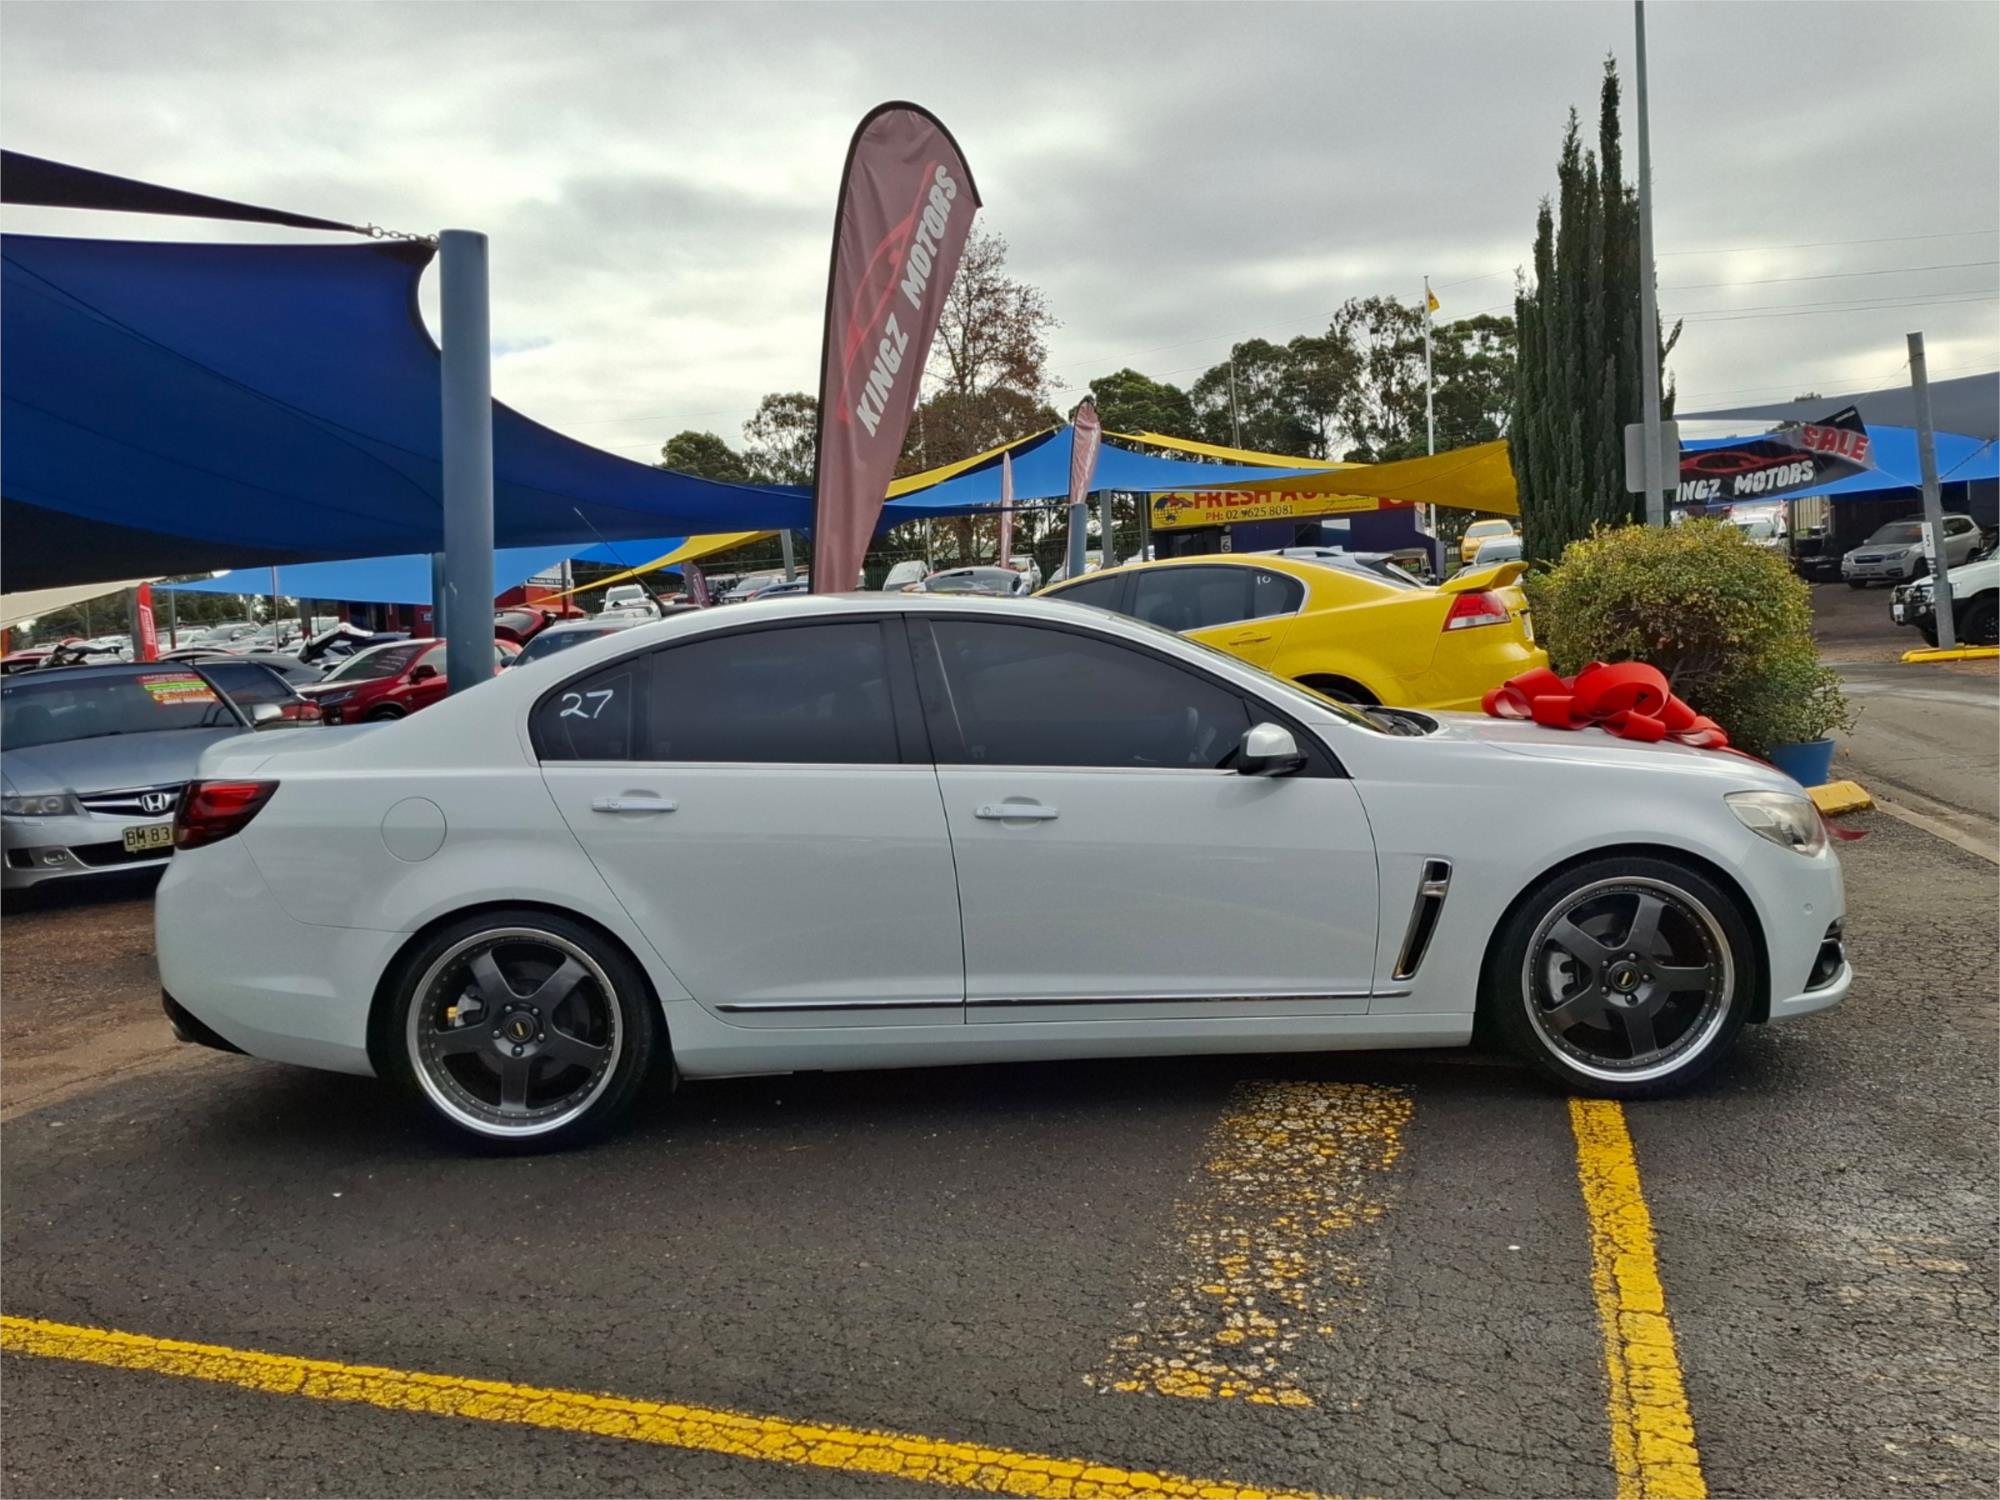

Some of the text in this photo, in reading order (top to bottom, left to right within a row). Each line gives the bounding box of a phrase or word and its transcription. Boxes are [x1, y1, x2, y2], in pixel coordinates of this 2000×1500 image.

[857, 165, 957, 437] KINGZ MOTORS
[1803, 424, 1869, 462] SALE
[1676, 460, 1814, 501] INGZ MOTORS
[1194, 491, 1272, 509] FRESH
[1206, 511, 1224, 520] PH:
[1226, 510, 1239, 520] 02
[1269, 505, 1293, 516] 8081
[1223, 541, 1231, 551] 6
[560, 689, 614, 719] 27
